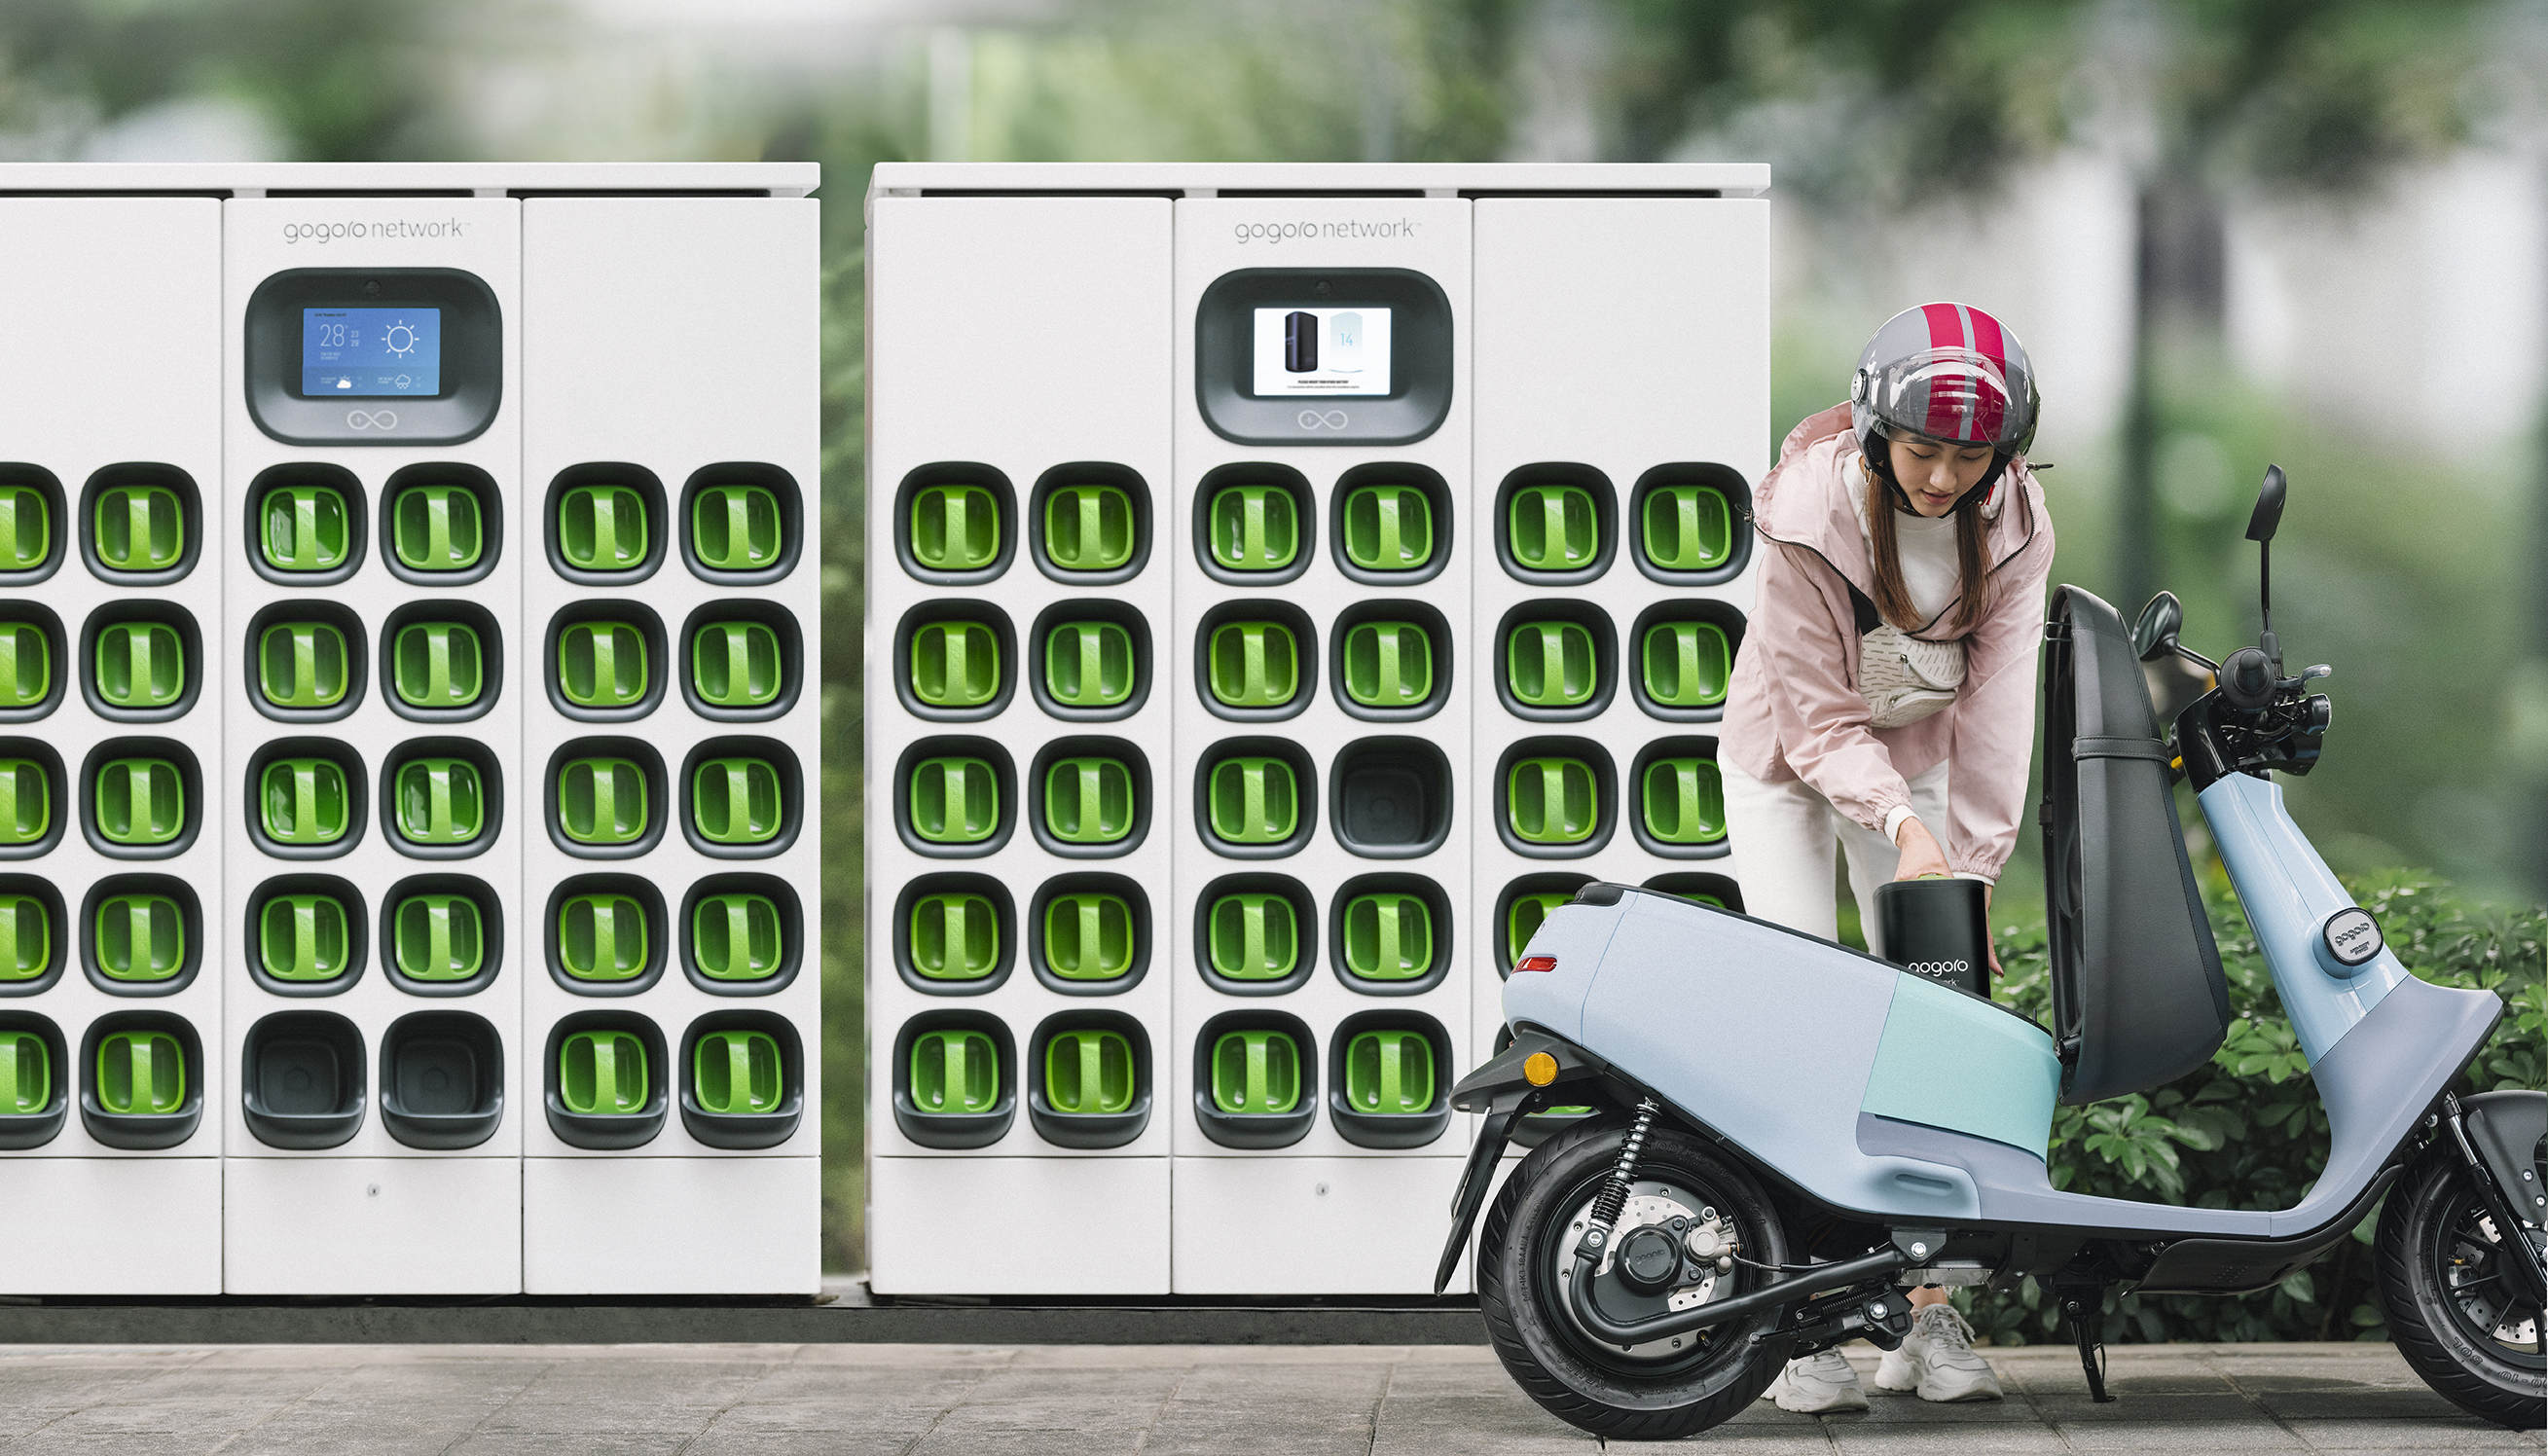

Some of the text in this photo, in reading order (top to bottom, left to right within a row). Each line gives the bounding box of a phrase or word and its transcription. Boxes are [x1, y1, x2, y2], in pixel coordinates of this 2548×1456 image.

[283, 221, 367, 244] gogoro
[1234, 221, 1318, 244] gogoro
[1340, 333, 1353, 346] 14
[2335, 922, 2370, 947] gogoro
[1634, 1249, 1665, 1265] gogoro
